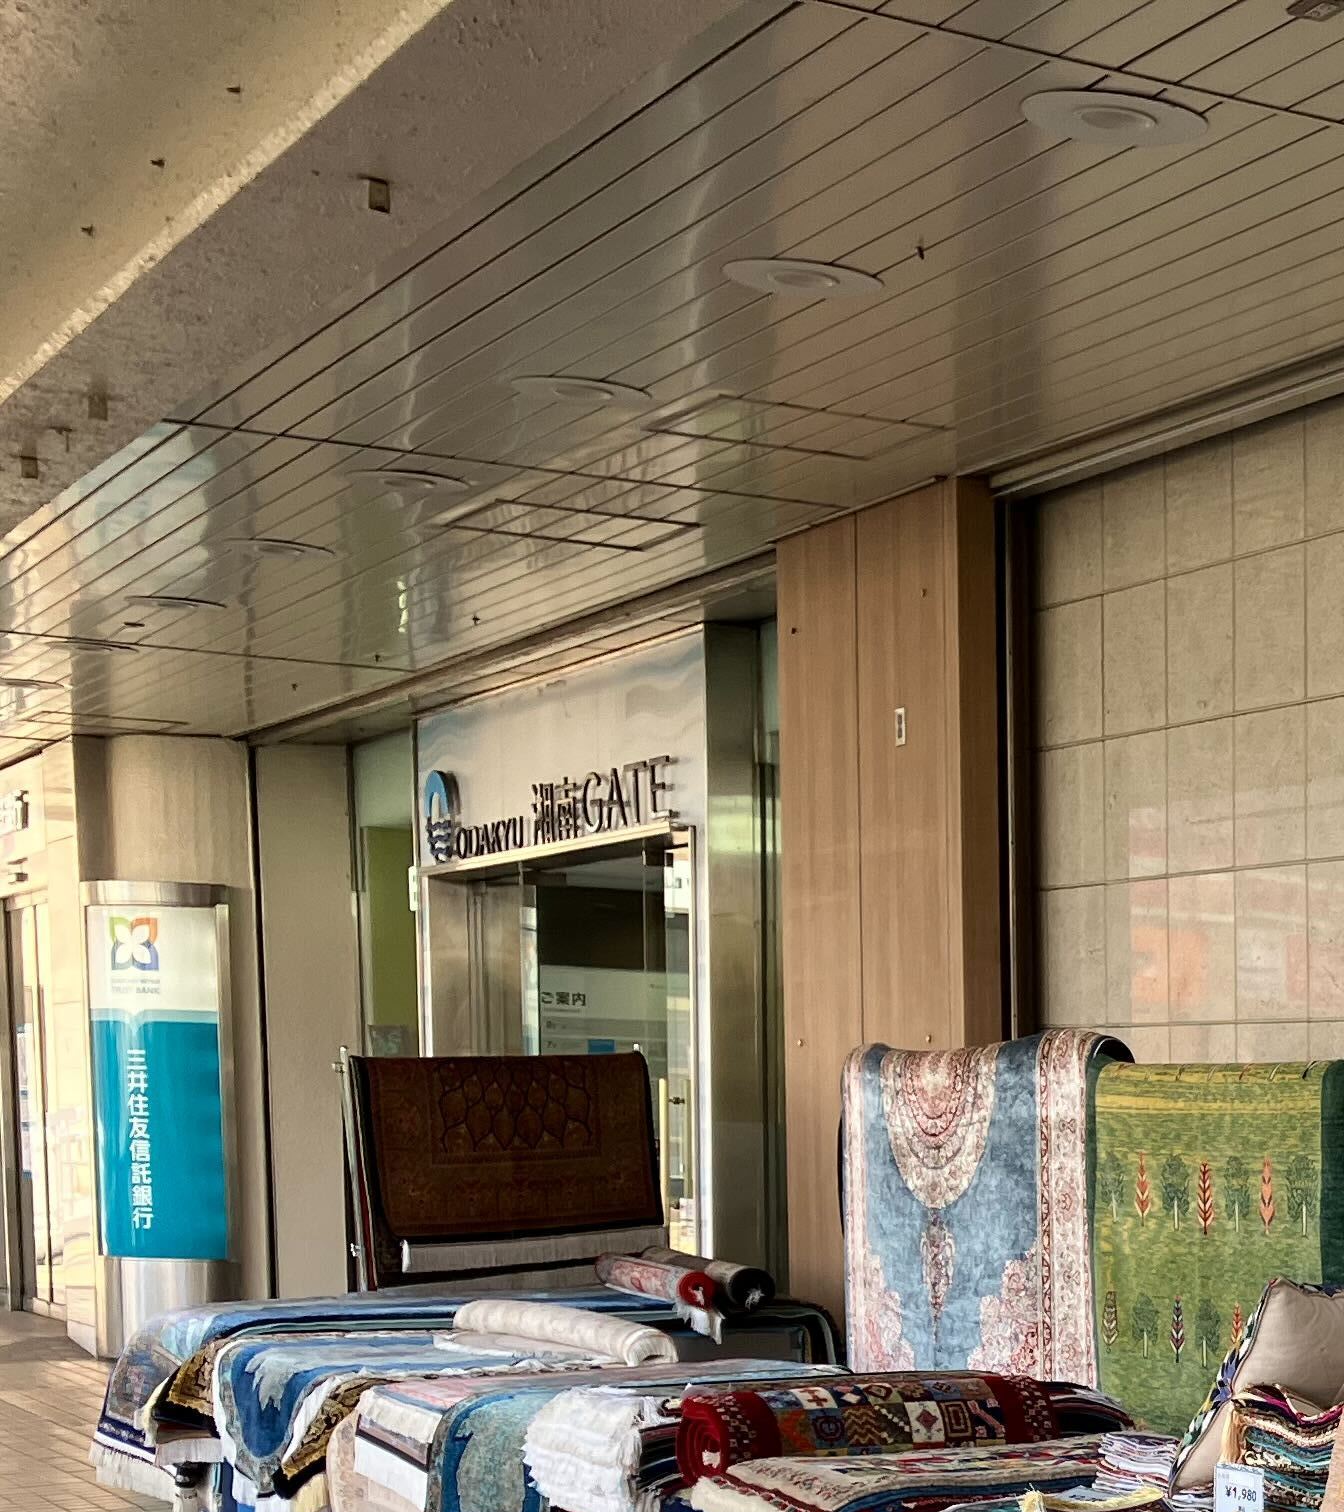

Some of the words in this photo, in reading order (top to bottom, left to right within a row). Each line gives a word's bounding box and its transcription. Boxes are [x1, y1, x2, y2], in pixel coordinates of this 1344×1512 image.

[455, 815, 524, 860] ODAKYU
[541, 991, 586, 1007] ご案内
[126, 1048, 154, 1230] 三井住友信託銀行
[1225, 1485, 1257, 1502] ¥1,980
